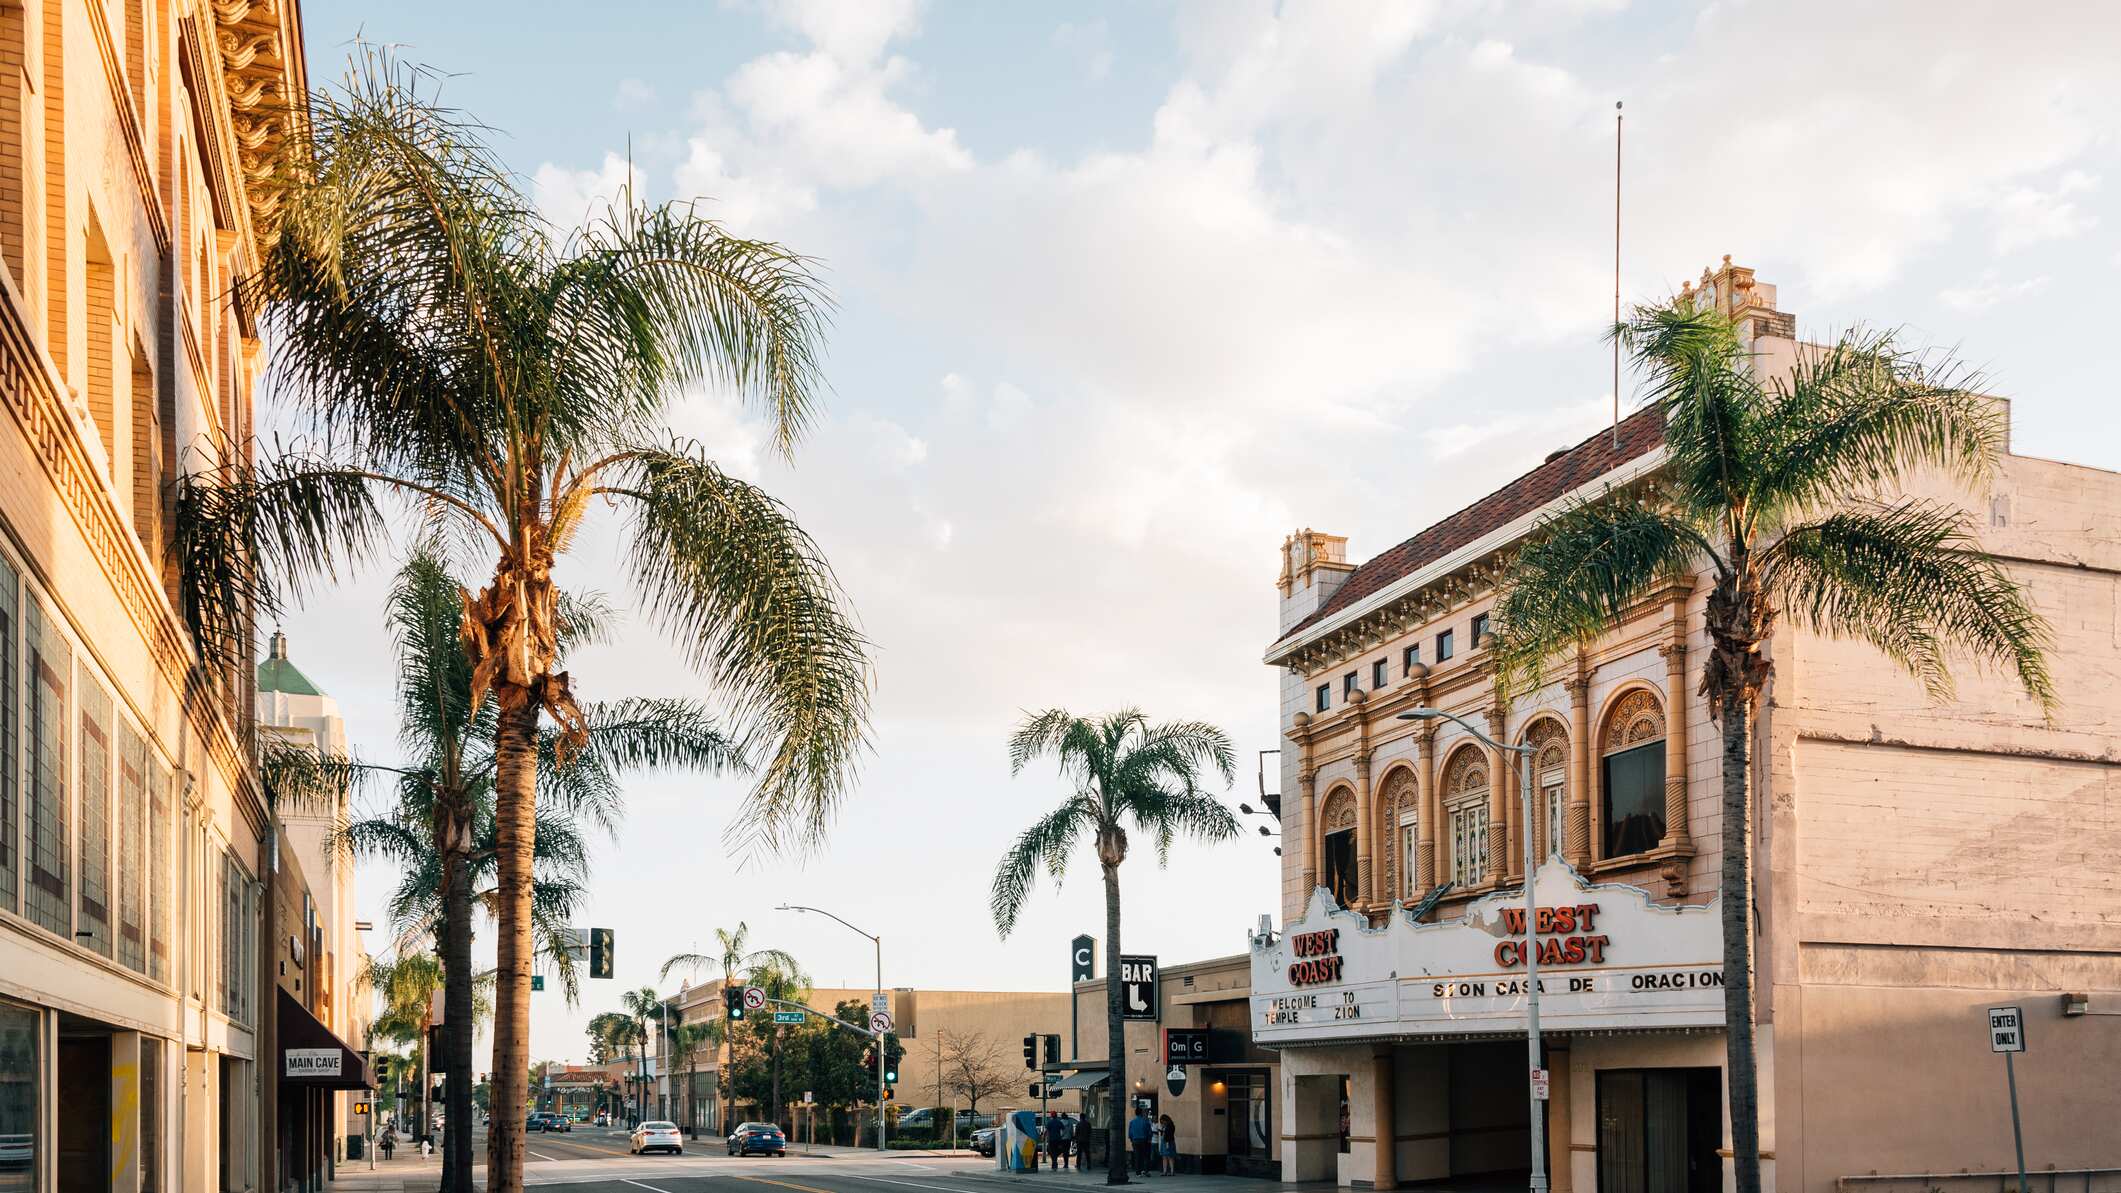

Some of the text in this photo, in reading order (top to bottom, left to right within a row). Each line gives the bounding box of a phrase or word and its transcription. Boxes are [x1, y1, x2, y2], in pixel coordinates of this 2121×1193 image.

[1502, 903, 1600, 936] WEST
[1292, 928, 1339, 957] WEST
[1494, 935, 1610, 968] COAST
[1121, 963, 1153, 983] BAR
[1288, 955, 1343, 986] COAST
[1569, 977, 1593, 992] DE
[1631, 972, 1725, 989] ORACION
[1272, 991, 1355, 1010] WELCOME TO
[1265, 1005, 1361, 1025] TEMPLE ZION
[1991, 1015, 2016, 1028] ENTER
[1193, 1041, 1203, 1052] G
[1995, 1032, 2015, 1045] ONLY
[288, 1057, 340, 1069] MAIN CAVE
